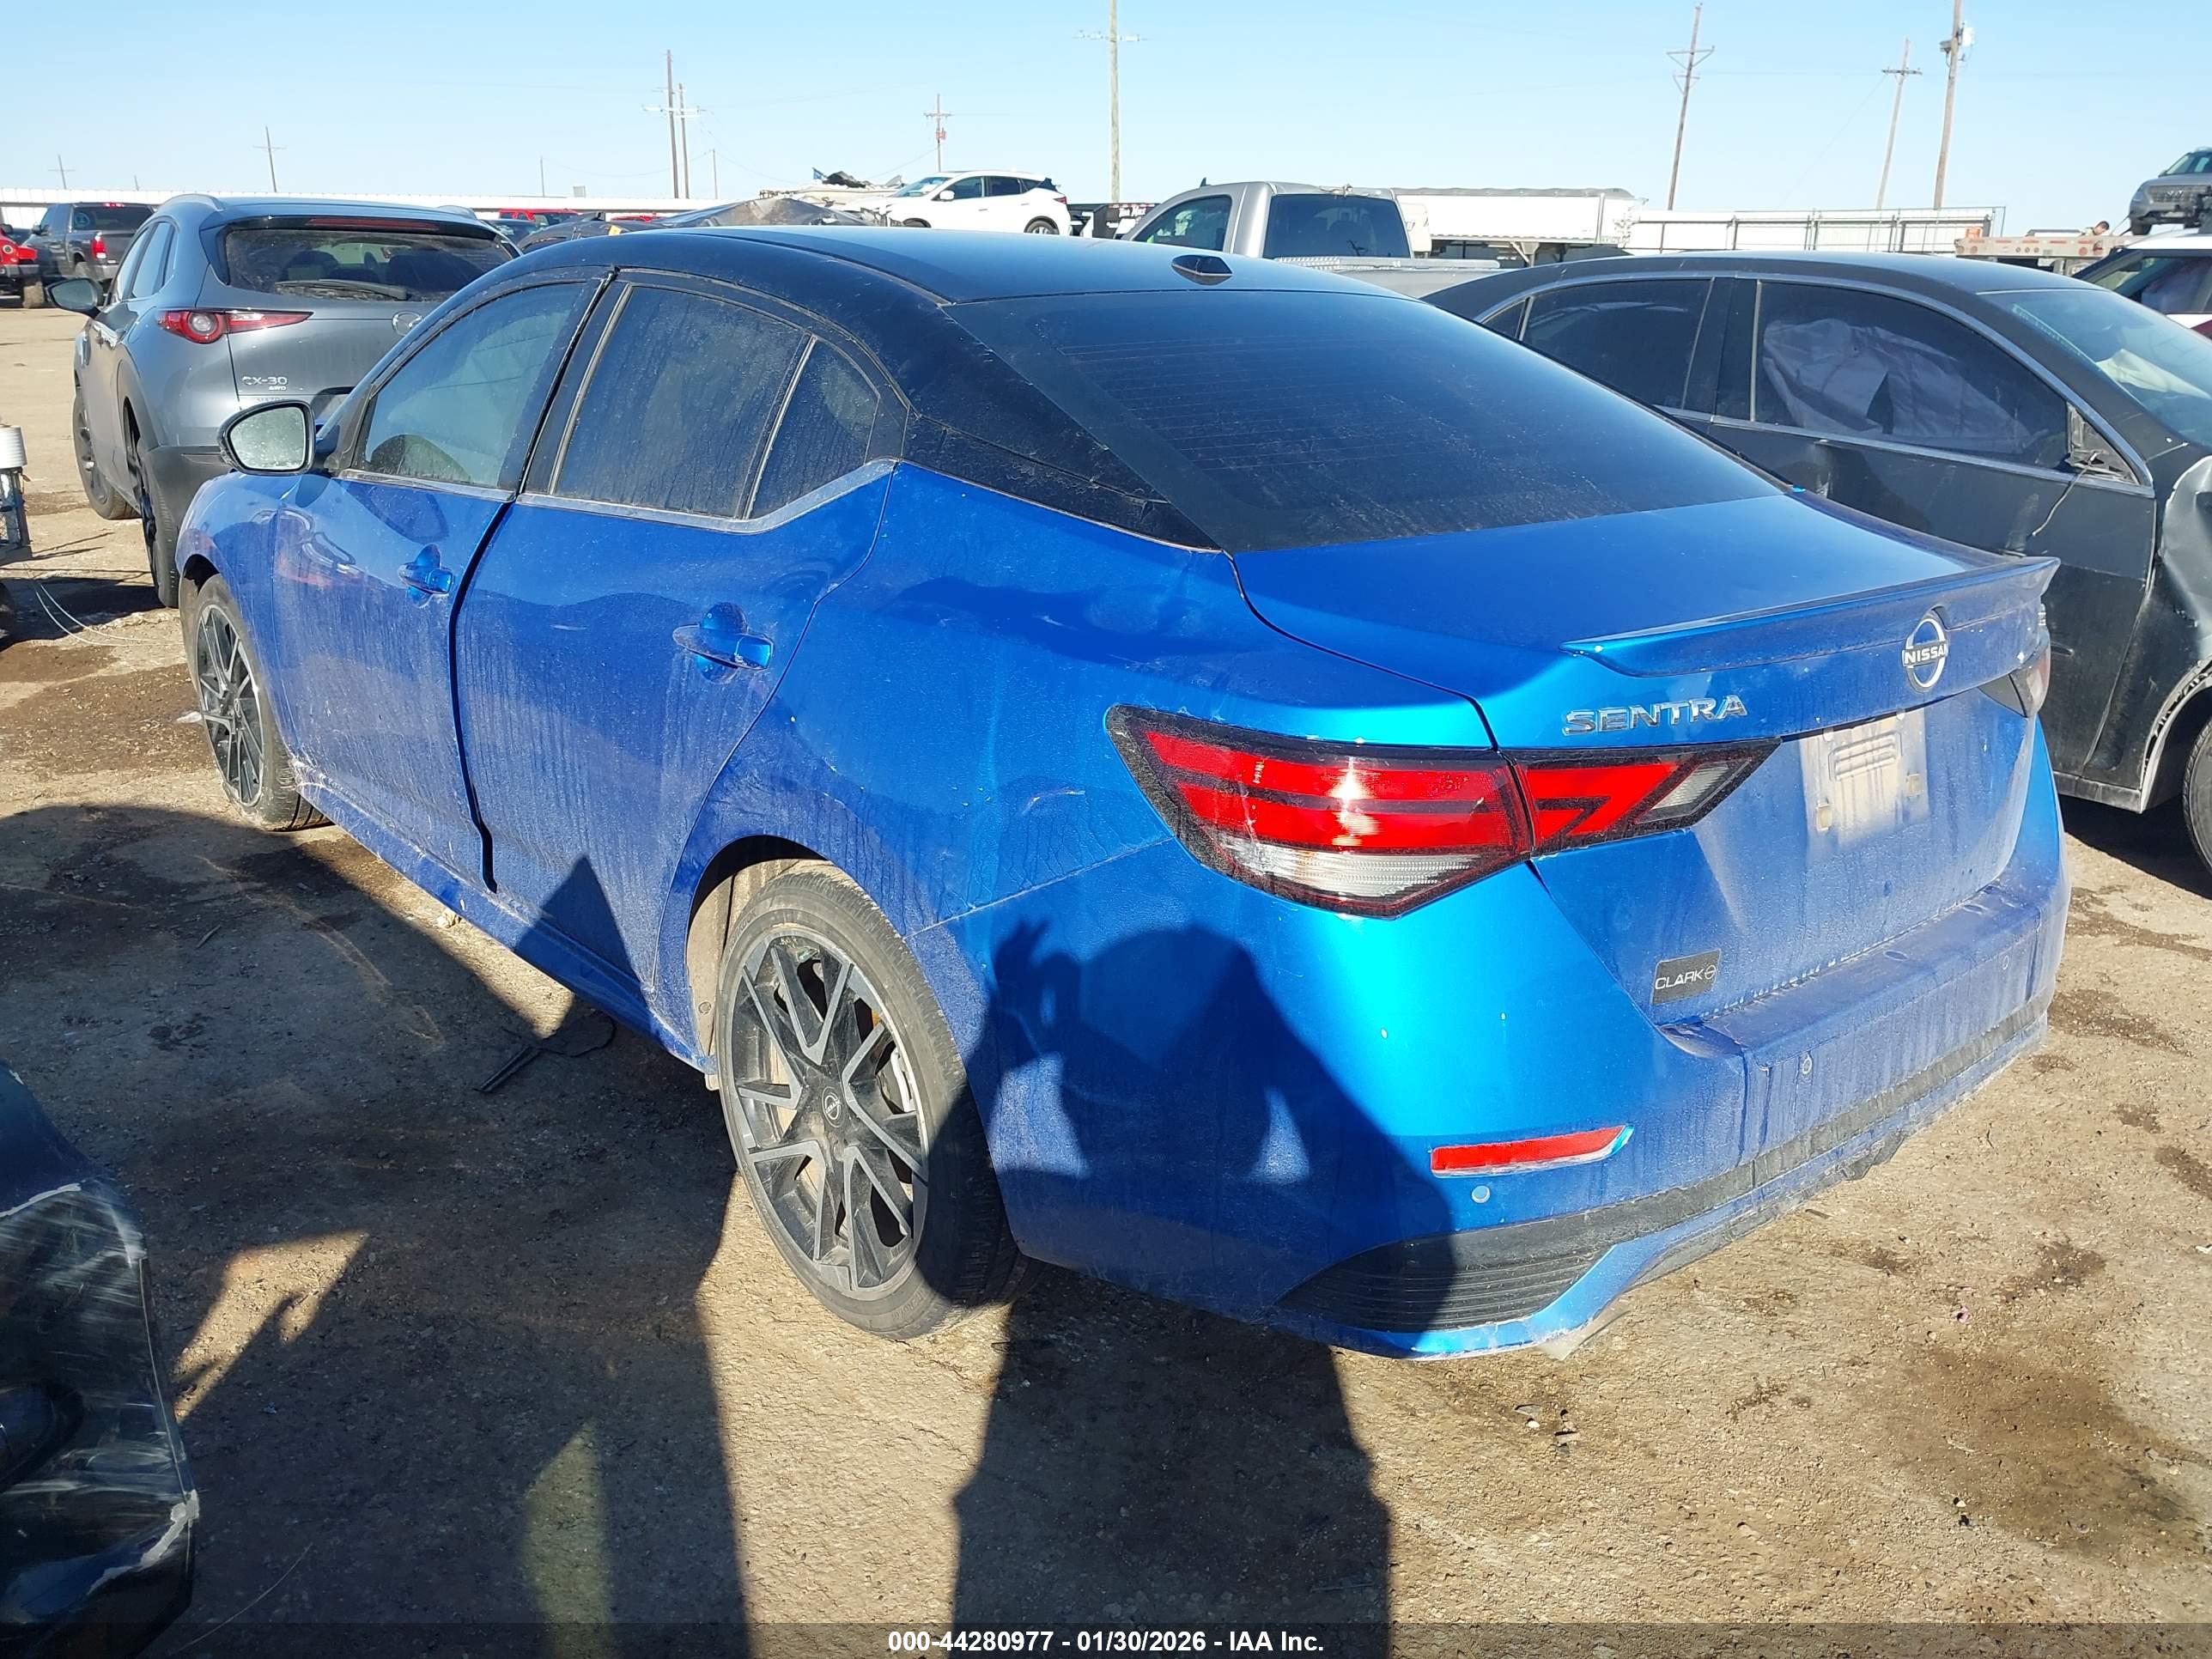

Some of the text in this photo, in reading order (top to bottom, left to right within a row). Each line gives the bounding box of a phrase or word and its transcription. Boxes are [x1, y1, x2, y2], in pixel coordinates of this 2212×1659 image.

[241, 375, 289, 386] CX-30
[1562, 693, 1748, 737] SENTRA
[1654, 968, 1705, 990] CLARK
